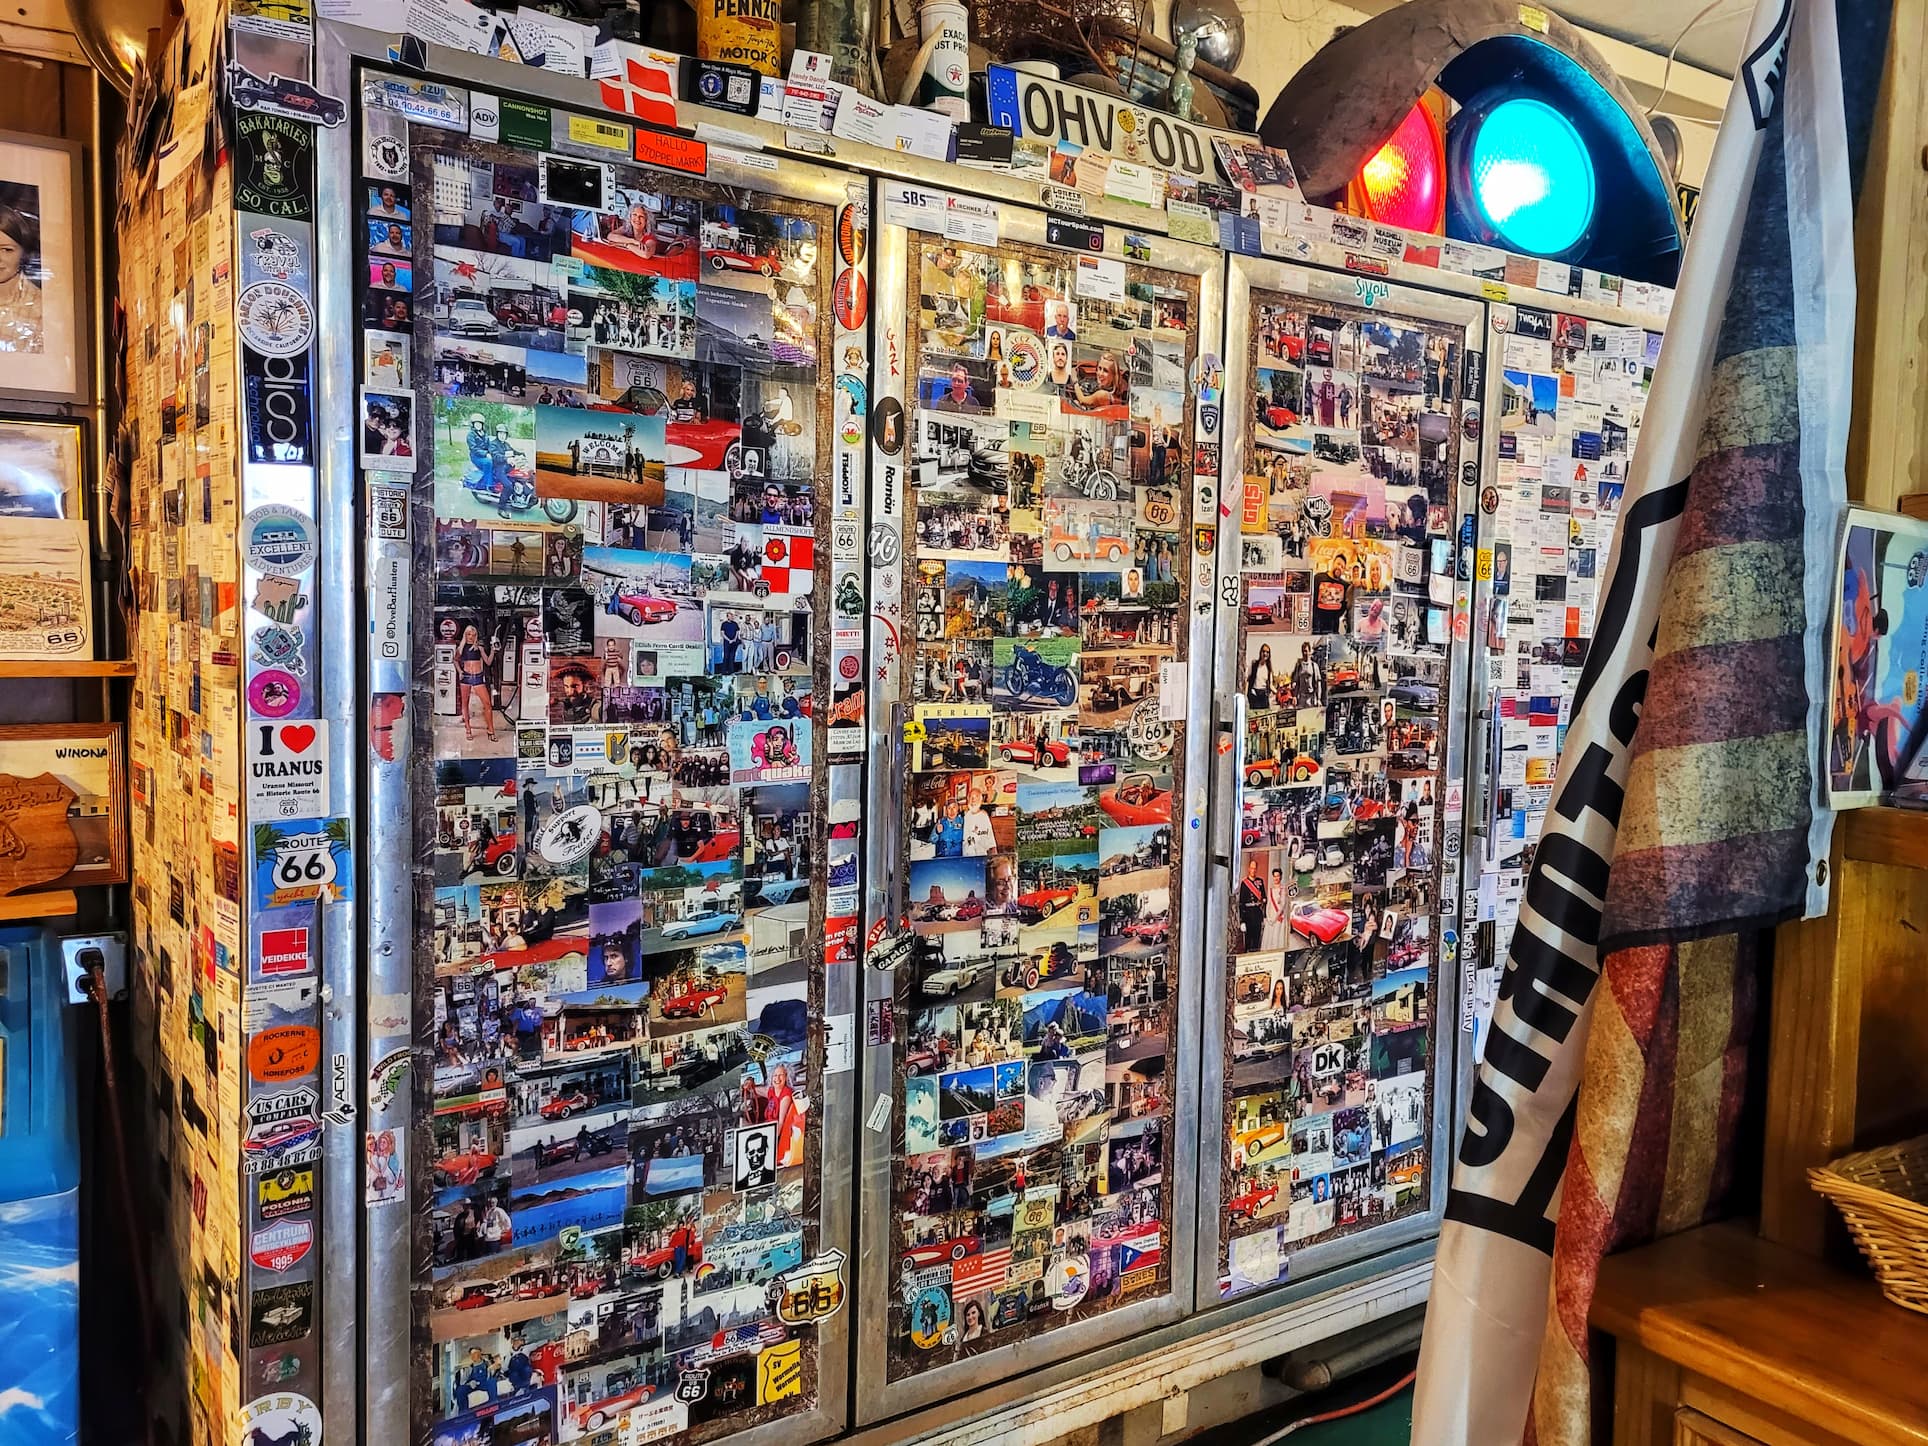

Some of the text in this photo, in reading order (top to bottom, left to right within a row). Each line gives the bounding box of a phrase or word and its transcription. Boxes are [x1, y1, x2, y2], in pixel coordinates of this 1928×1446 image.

[943, 29, 967, 41] EXACO
[934, 40, 950, 50] UST
[720, 47, 768, 63] MOTOR
[503, 102, 547, 115] CANNONSHOT
[475, 112, 495, 123] ADV
[1001, 112, 1012, 127] D
[240, 116, 308, 147] BAKATARIES
[1024, 82, 1204, 175] OHV OD
[655, 137, 688, 151] HALLO
[240, 189, 308, 215] SO. CAL.
[902, 191, 927, 207] SBS
[634, 376, 651, 386] 66
[582, 439, 624, 456] WELCOME
[1244, 484, 1263, 524] GAS
[249, 507, 269, 524] BOB
[381, 512, 397, 522] 66
[1152, 505, 1168, 521] 66
[838, 534, 854, 546] 66
[250, 543, 313, 556] EXCELLENT
[250, 554, 313, 576] ADVENTURES
[1407, 566, 1416, 574] 66
[387, 561, 397, 639] @DiveBarHunters
[756, 588, 766, 597] 66
[1298, 618, 1308, 627] 66
[48, 633, 78, 644] 66
[259, 725, 274, 756] I
[1146, 726, 1161, 740] 66
[56, 748, 108, 759] WINONA
[252, 760, 323, 778] URANUS
[548, 809, 576, 832] Support
[283, 838, 323, 850] ROUTE
[281, 853, 326, 883] 66
[261, 952, 308, 964] VEIDEKKE
[878, 942, 913, 970] GARAGE
[457, 982, 470, 990] 66
[375, 1055, 393, 1072] WILD
[1315, 1052, 1342, 1072] DK
[256, 1093, 308, 1114] US CARS
[259, 1107, 306, 1123] COMPANY
[244, 1148, 322, 1174] 03 88 48 87 09
[262, 1196, 312, 1212] POLONIA
[1028, 1212, 1042, 1222] 66
[271, 1254, 294, 1269] 1995
[1122, 1270, 1154, 1286] BONES
[794, 1287, 832, 1316] 66
[726, 1334, 737, 1344] 66
[682, 1386, 702, 1398] 66
